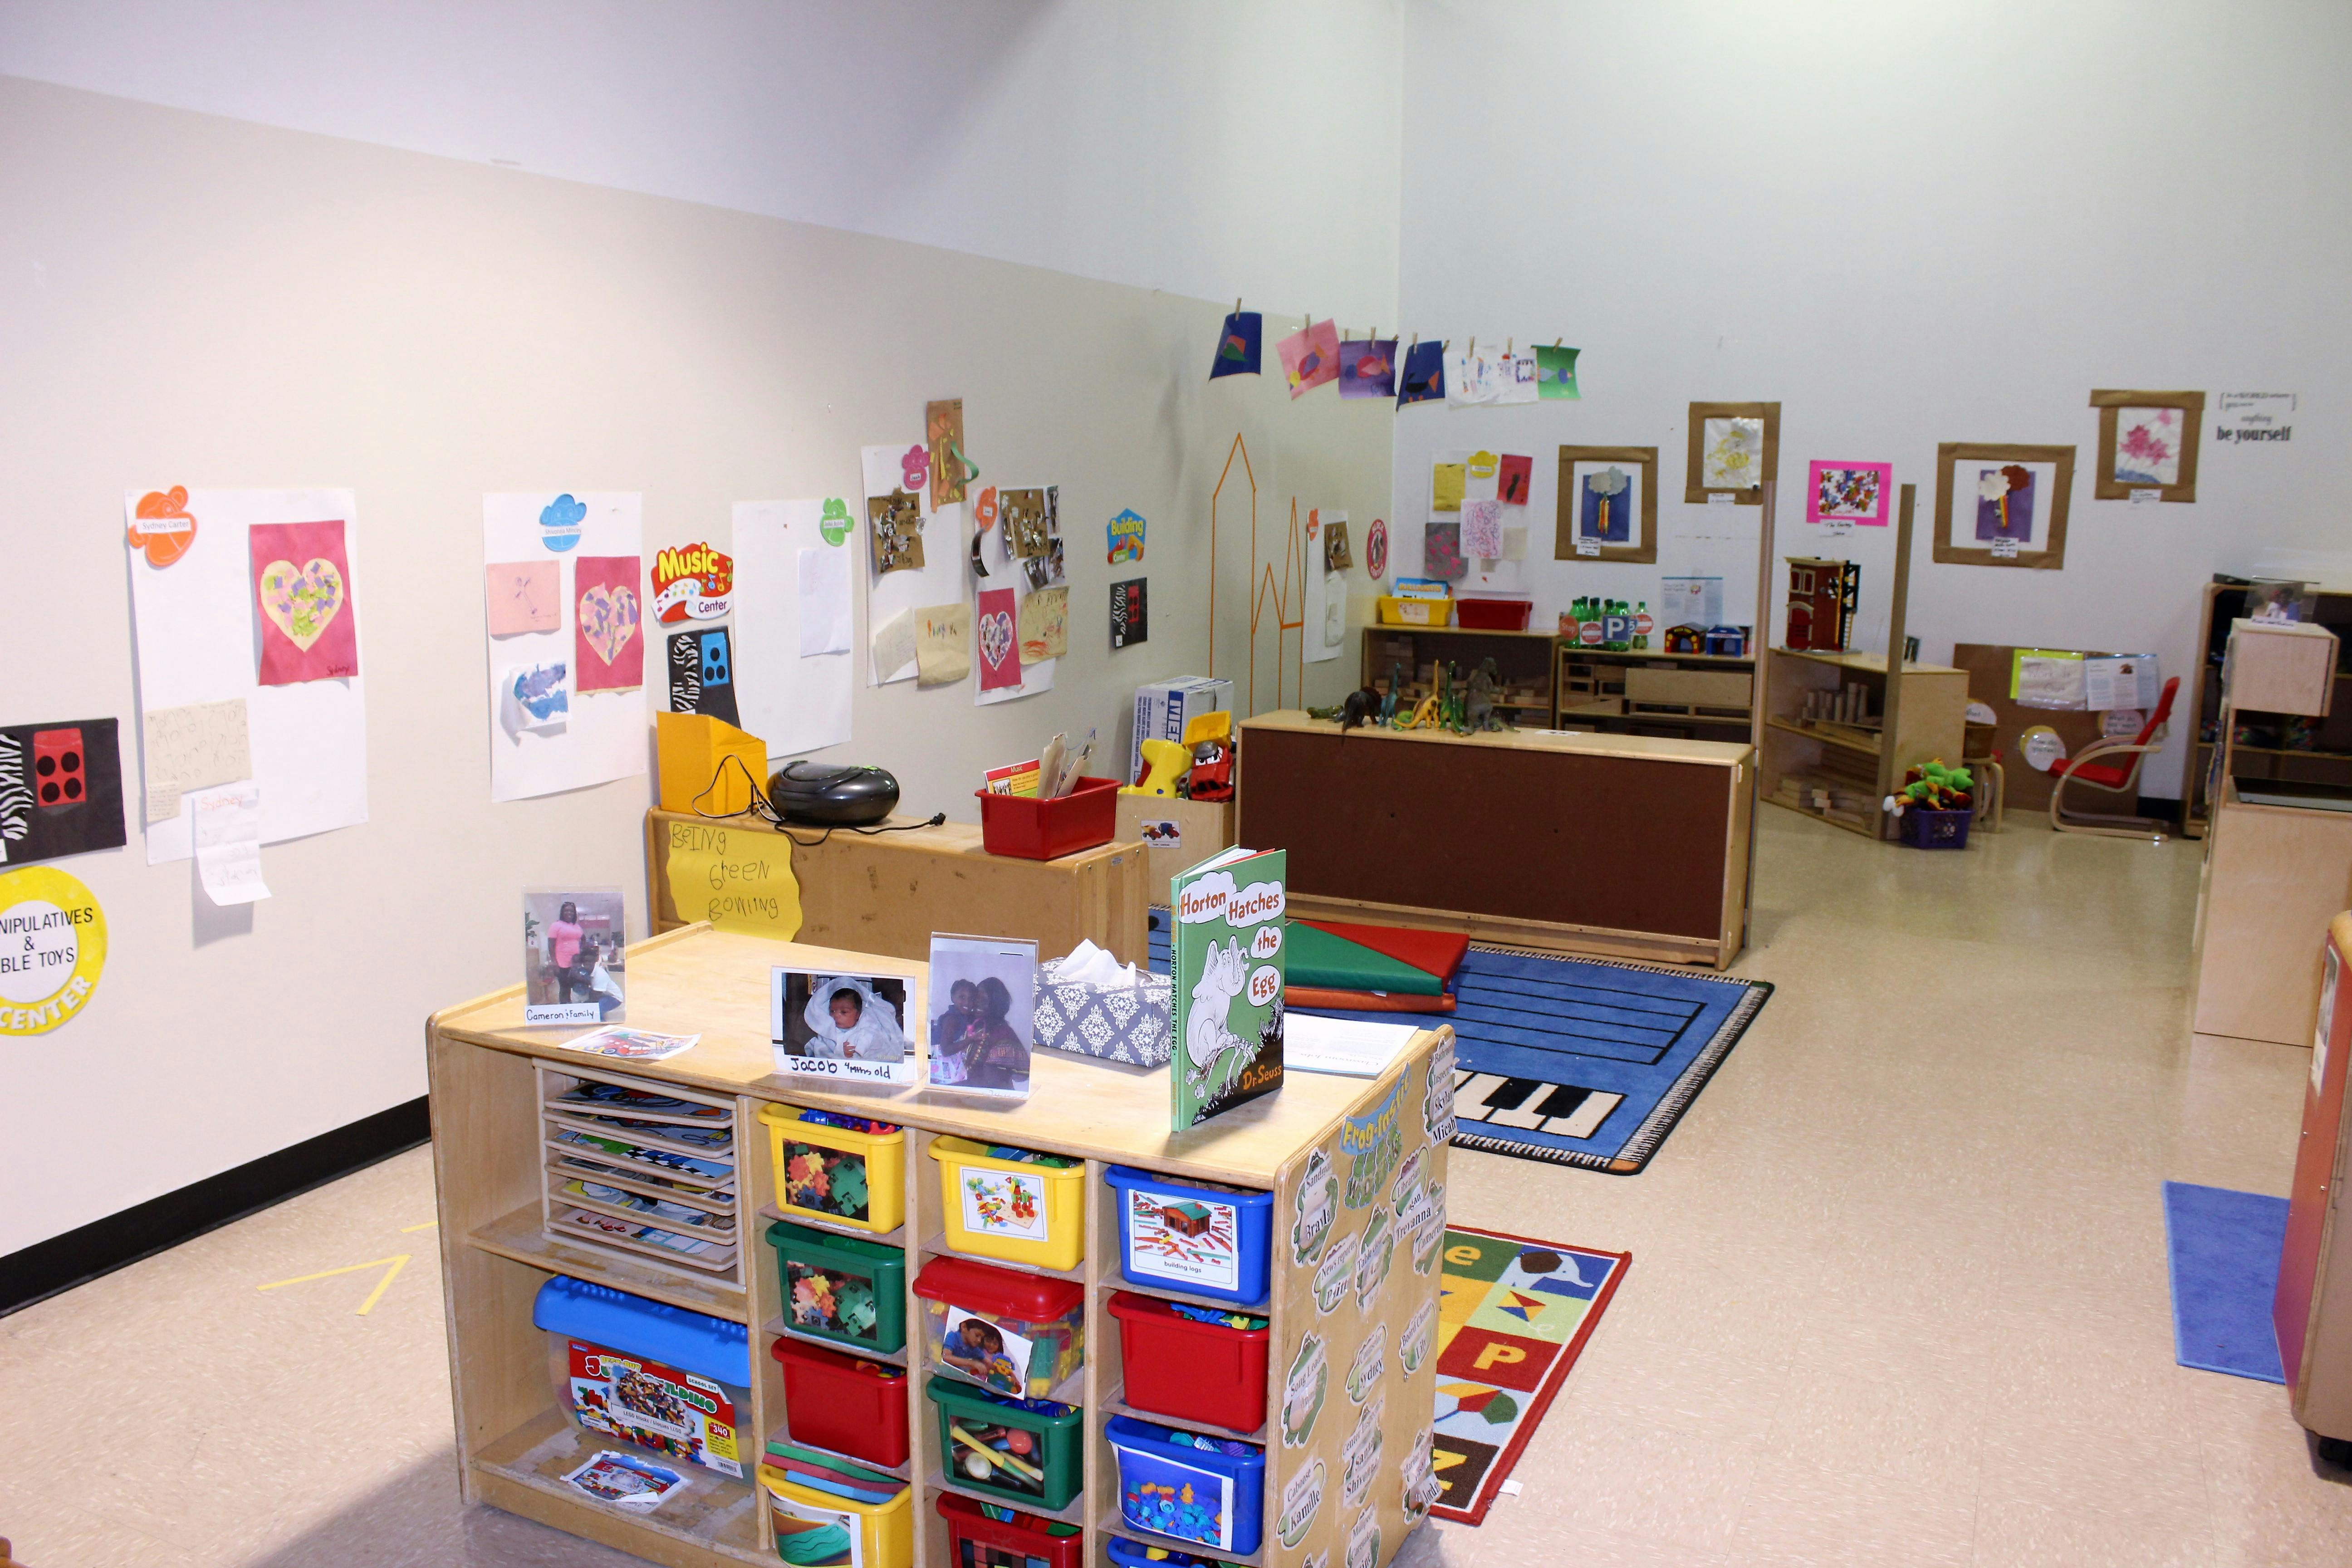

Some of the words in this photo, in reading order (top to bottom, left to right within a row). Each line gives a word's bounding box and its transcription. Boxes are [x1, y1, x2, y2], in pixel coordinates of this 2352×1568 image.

[2217, 426, 2232, 440] be
[2234, 426, 2291, 444] yourself
[1111, 517, 1143, 536] Building
[659, 544, 719, 583] Music
[699, 600, 727, 612] Center
[1562, 622, 1576, 633] Stop
[1607, 617, 1625, 639] P
[201, 794, 244, 811] Sydney
[1181, 890, 1226, 917] Horton
[1229, 893, 1279, 921] Hatches
[24, 936, 34, 951] &
[1257, 930, 1277, 952] the
[0, 955, 31, 974] BLE
[38, 947, 74, 967] TOYS
[1253, 972, 1276, 998] Egg
[0, 975, 93, 1029] CENTER
[527, 1009, 564, 1021] Cameron
[569, 1010, 594, 1019] Family
[875, 1065, 890, 1079] old
[1243, 1070, 1258, 1090] Dr.
[1259, 1064, 1283, 1083] Seuss
[1433, 1118, 1456, 1145] Micah
[1397, 1166, 1421, 1197] Librarian
[1418, 1219, 1444, 1253] Cameron
[1165, 1261, 1187, 1271] building
[1321, 1263, 1337, 1279] News
[1357, 1253, 1372, 1271] Table
[1402, 1322, 1416, 1347] Board
[688, 1377, 707, 1388] SCHOOL
[1291, 1376, 1306, 1396] Song
[1307, 1348, 1324, 1376] Leader
[1360, 1357, 1383, 1389] Sydney
[623, 1410, 635, 1420] LEGO
[636, 1414, 649, 1424] blocks
[653, 1419, 669, 1431] bloques
[670, 1426, 682, 1434] LEGO
[713, 1424, 728, 1436] 340
[1343, 1432, 1360, 1456] Center
[1287, 1468, 1312, 1502] Caboose
[1290, 1489, 1321, 1532] Kamille
